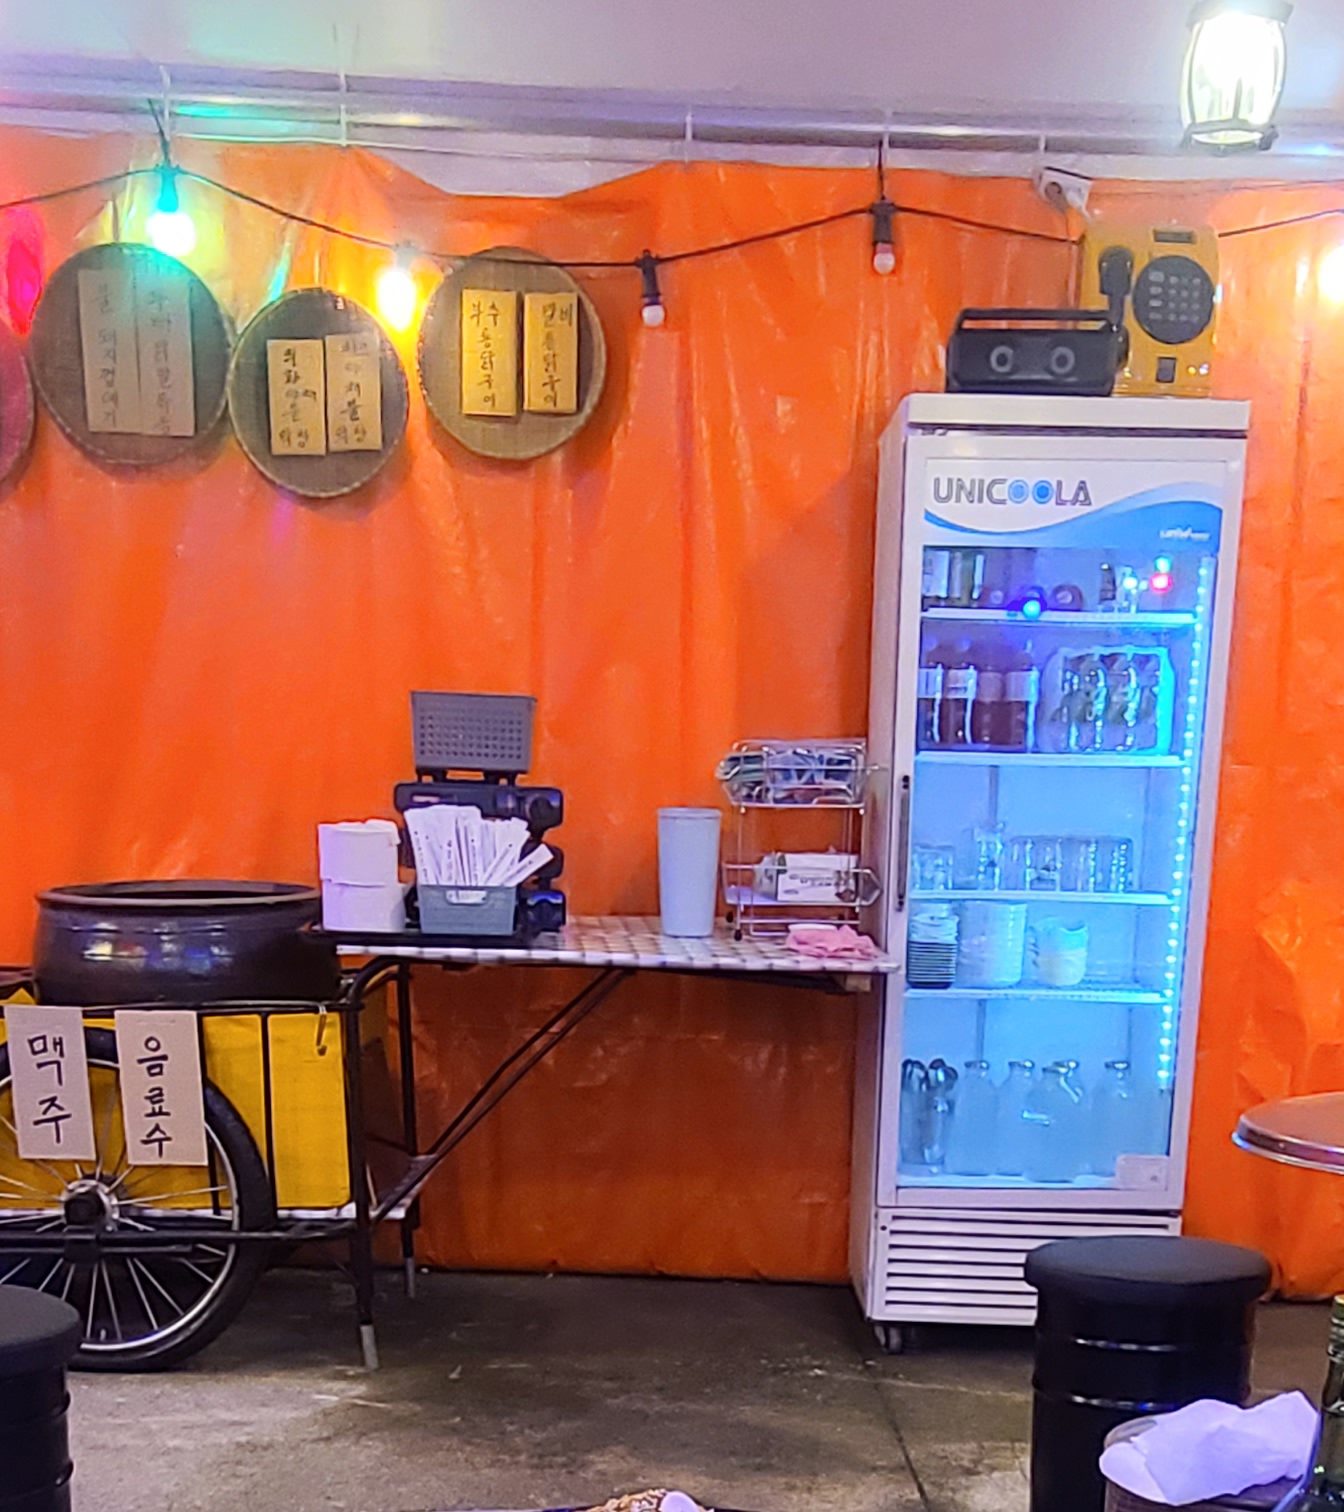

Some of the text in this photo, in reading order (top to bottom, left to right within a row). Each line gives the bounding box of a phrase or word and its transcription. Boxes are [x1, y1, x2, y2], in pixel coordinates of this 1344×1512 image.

[933, 477, 1092, 506] UNICOOLA
[27, 1034, 73, 1144] 맥주
[136, 1036, 173, 1158] 음료수
